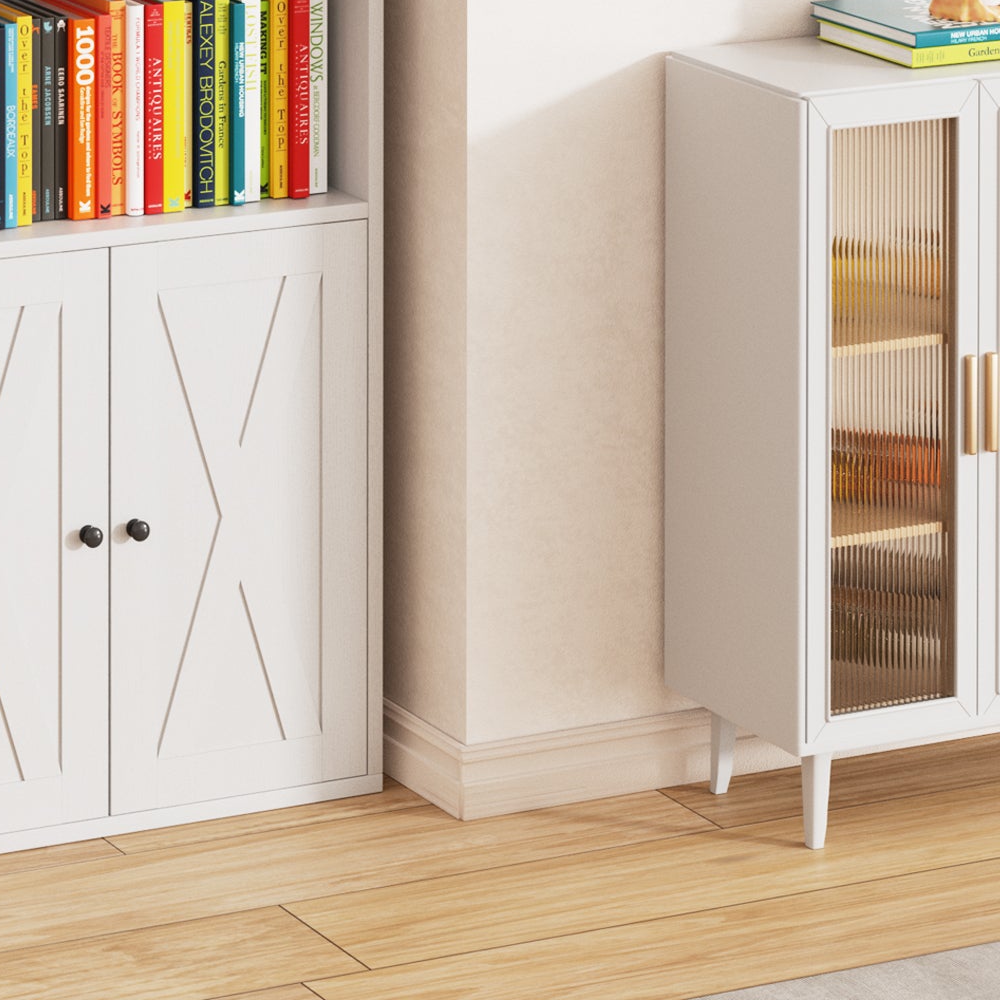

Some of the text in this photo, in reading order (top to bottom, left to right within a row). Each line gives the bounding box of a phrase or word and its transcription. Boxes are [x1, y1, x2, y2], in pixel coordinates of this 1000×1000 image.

[76, 26, 95, 85] 1000
[260, 10, 268, 59] MAKING
[309, 1, 324, 83] WINDOWS
[950, 31, 965, 39] NEW
[966, 29, 989, 38] URBAN
[112, 51, 123, 95] BOOK
[199, 0, 214, 194] ALEXEY BRODOVITCH
[260, 61, 268, 75] IT
[297, 44, 309, 145] ANTIQUAIRES
[6, 104, 16, 158] BORDEAUX
[150, 57, 163, 160] ANTIQUAIRES
[218, 60, 227, 149] Gardens in France
[112, 110, 123, 186] SYMBOLS
